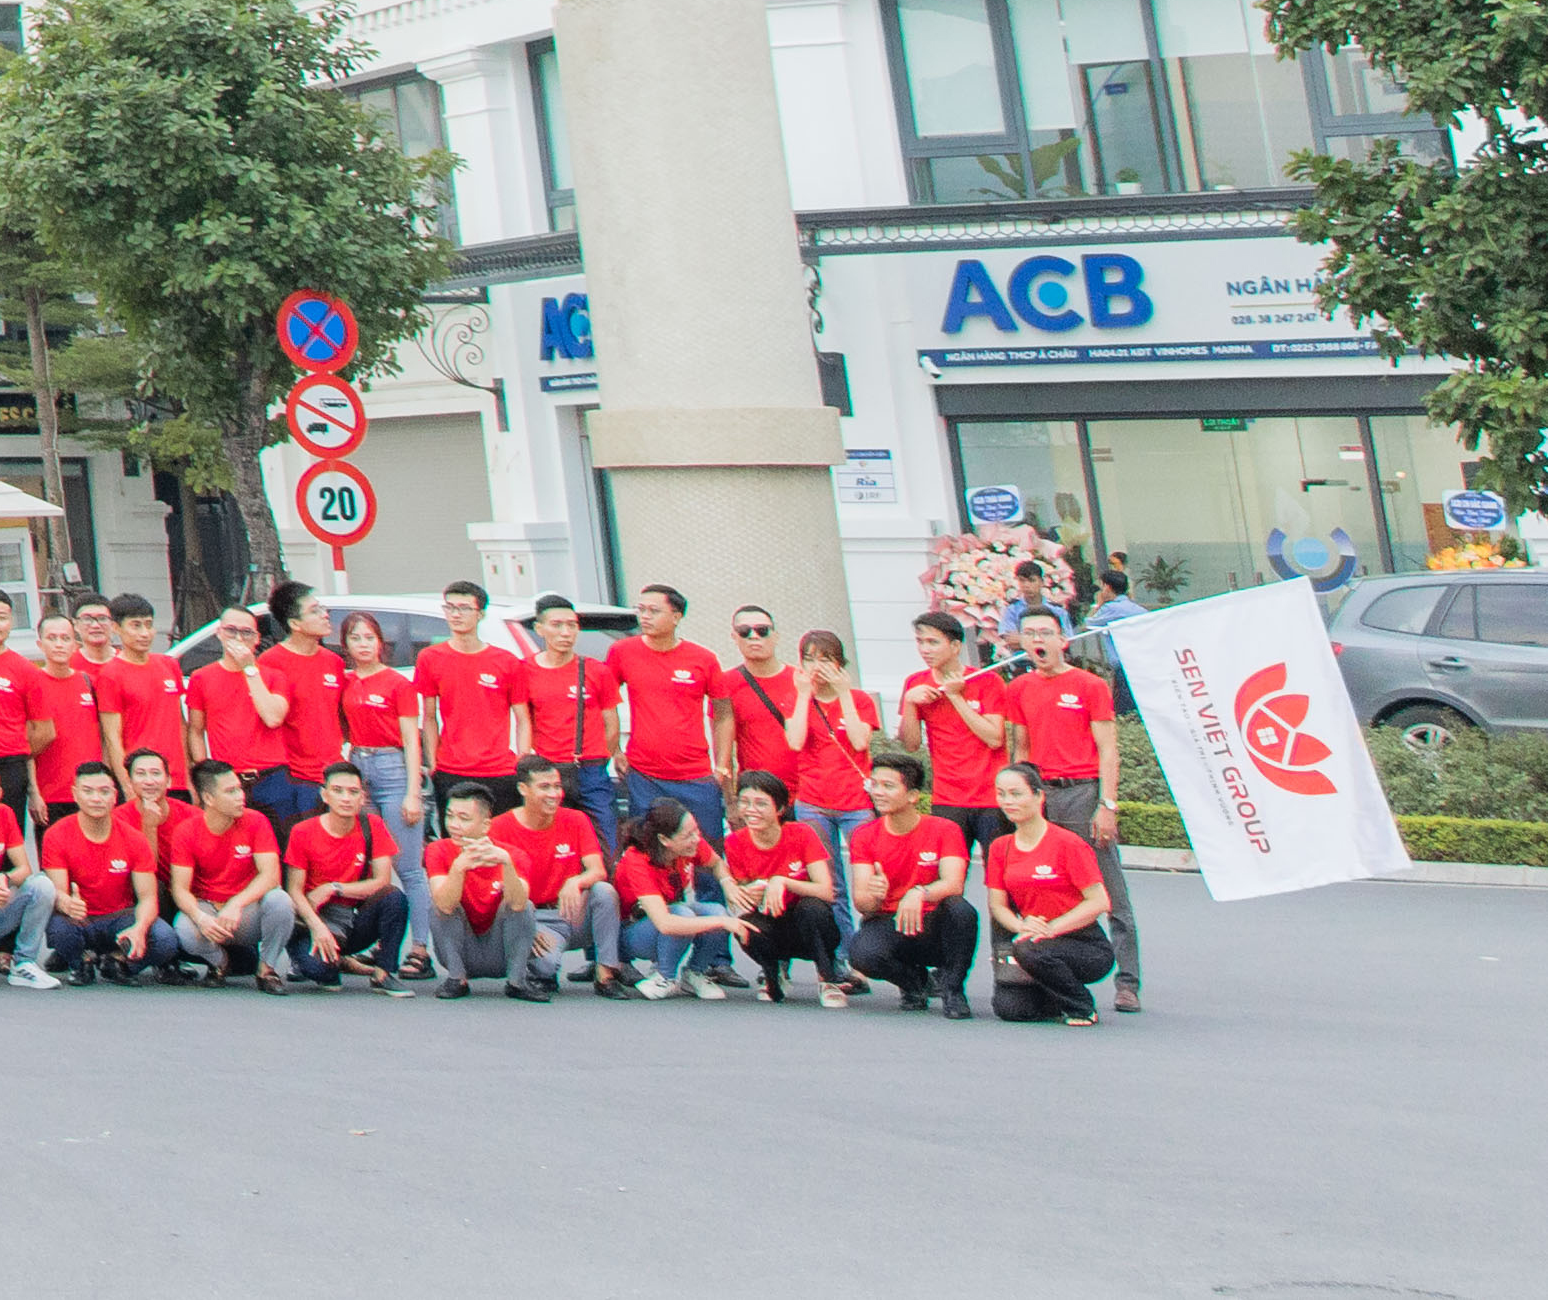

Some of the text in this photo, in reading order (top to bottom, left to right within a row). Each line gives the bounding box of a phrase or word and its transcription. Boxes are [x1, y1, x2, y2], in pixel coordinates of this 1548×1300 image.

[941, 254, 1154, 334] ACB
[1226, 276, 1290, 296] NGÂN
[540, 292, 594, 361] AC
[319, 486, 357, 521] 20
[1174, 648, 1271, 854] SEN VIỆT GROUP
